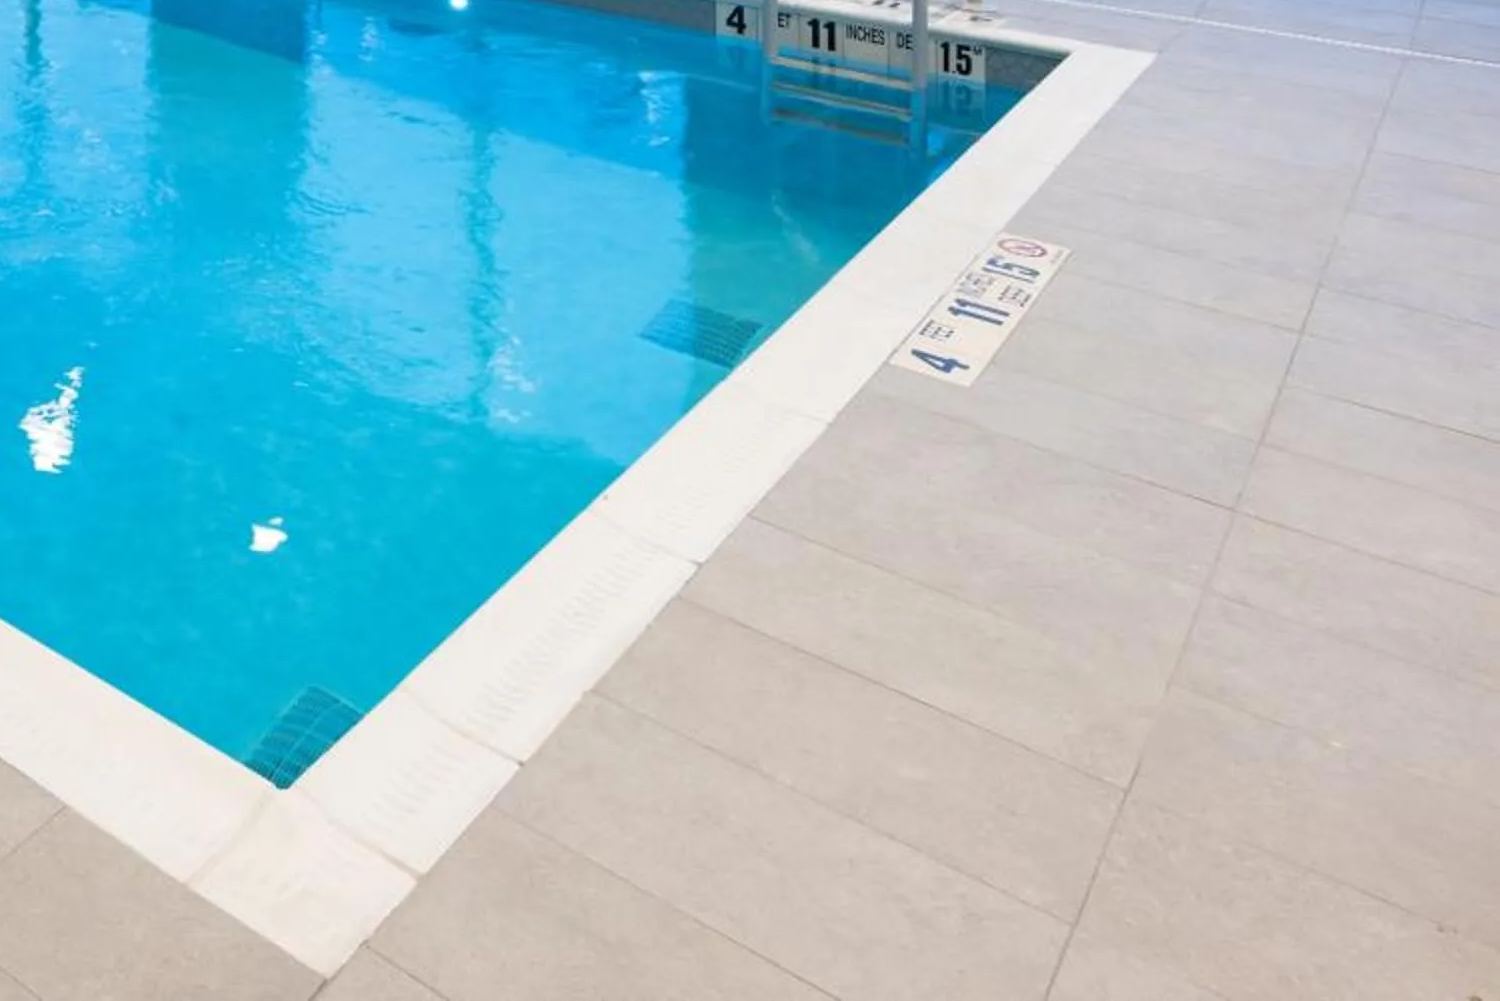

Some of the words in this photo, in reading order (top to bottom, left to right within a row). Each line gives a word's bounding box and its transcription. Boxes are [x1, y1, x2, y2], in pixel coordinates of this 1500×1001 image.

[726, 5, 747, 34] 4
[807, 17, 836, 52] 11
[846, 24, 885, 46] INCHES
[911, 348, 970, 374] 4
[948, 298, 1010, 326] 11
